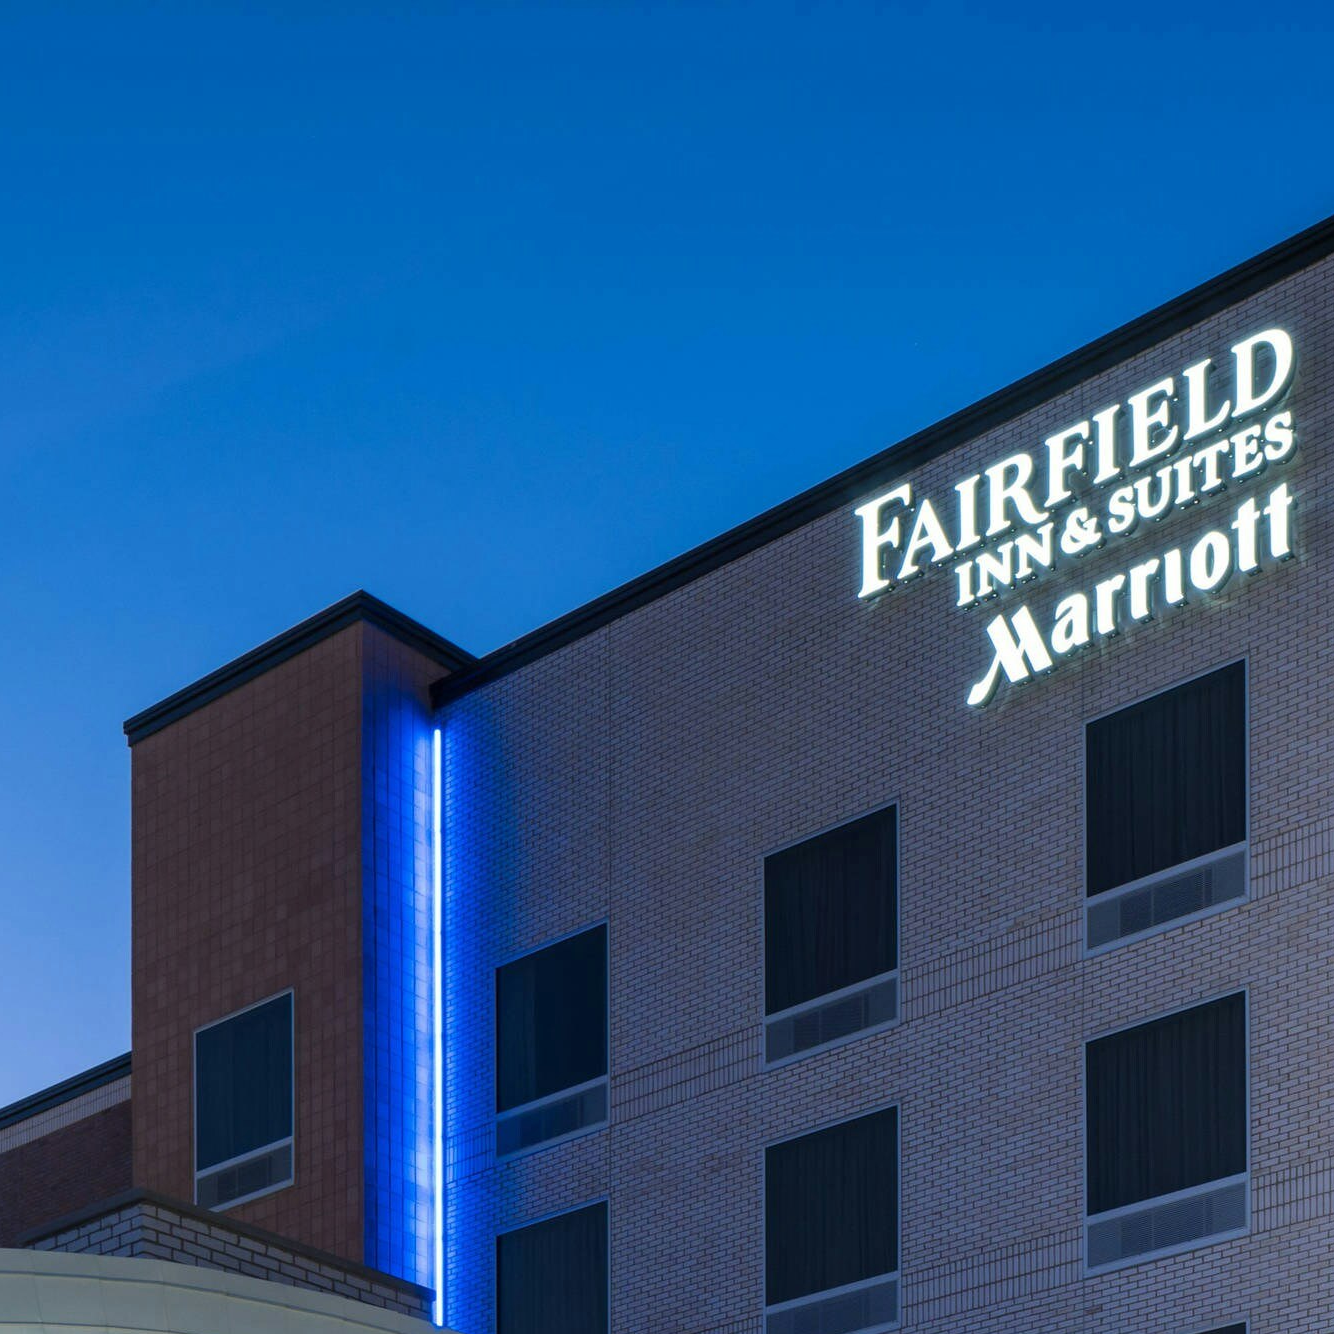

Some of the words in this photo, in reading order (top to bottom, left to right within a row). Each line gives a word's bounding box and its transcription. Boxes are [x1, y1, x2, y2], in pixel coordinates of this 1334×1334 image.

[854, 328, 1294, 599] FAIRFIELD
[954, 521, 1055, 607] INN
[1061, 506, 1102, 555] &
[1107, 410, 1294, 535] SUITES
[966, 482, 1294, 706] Marriott
